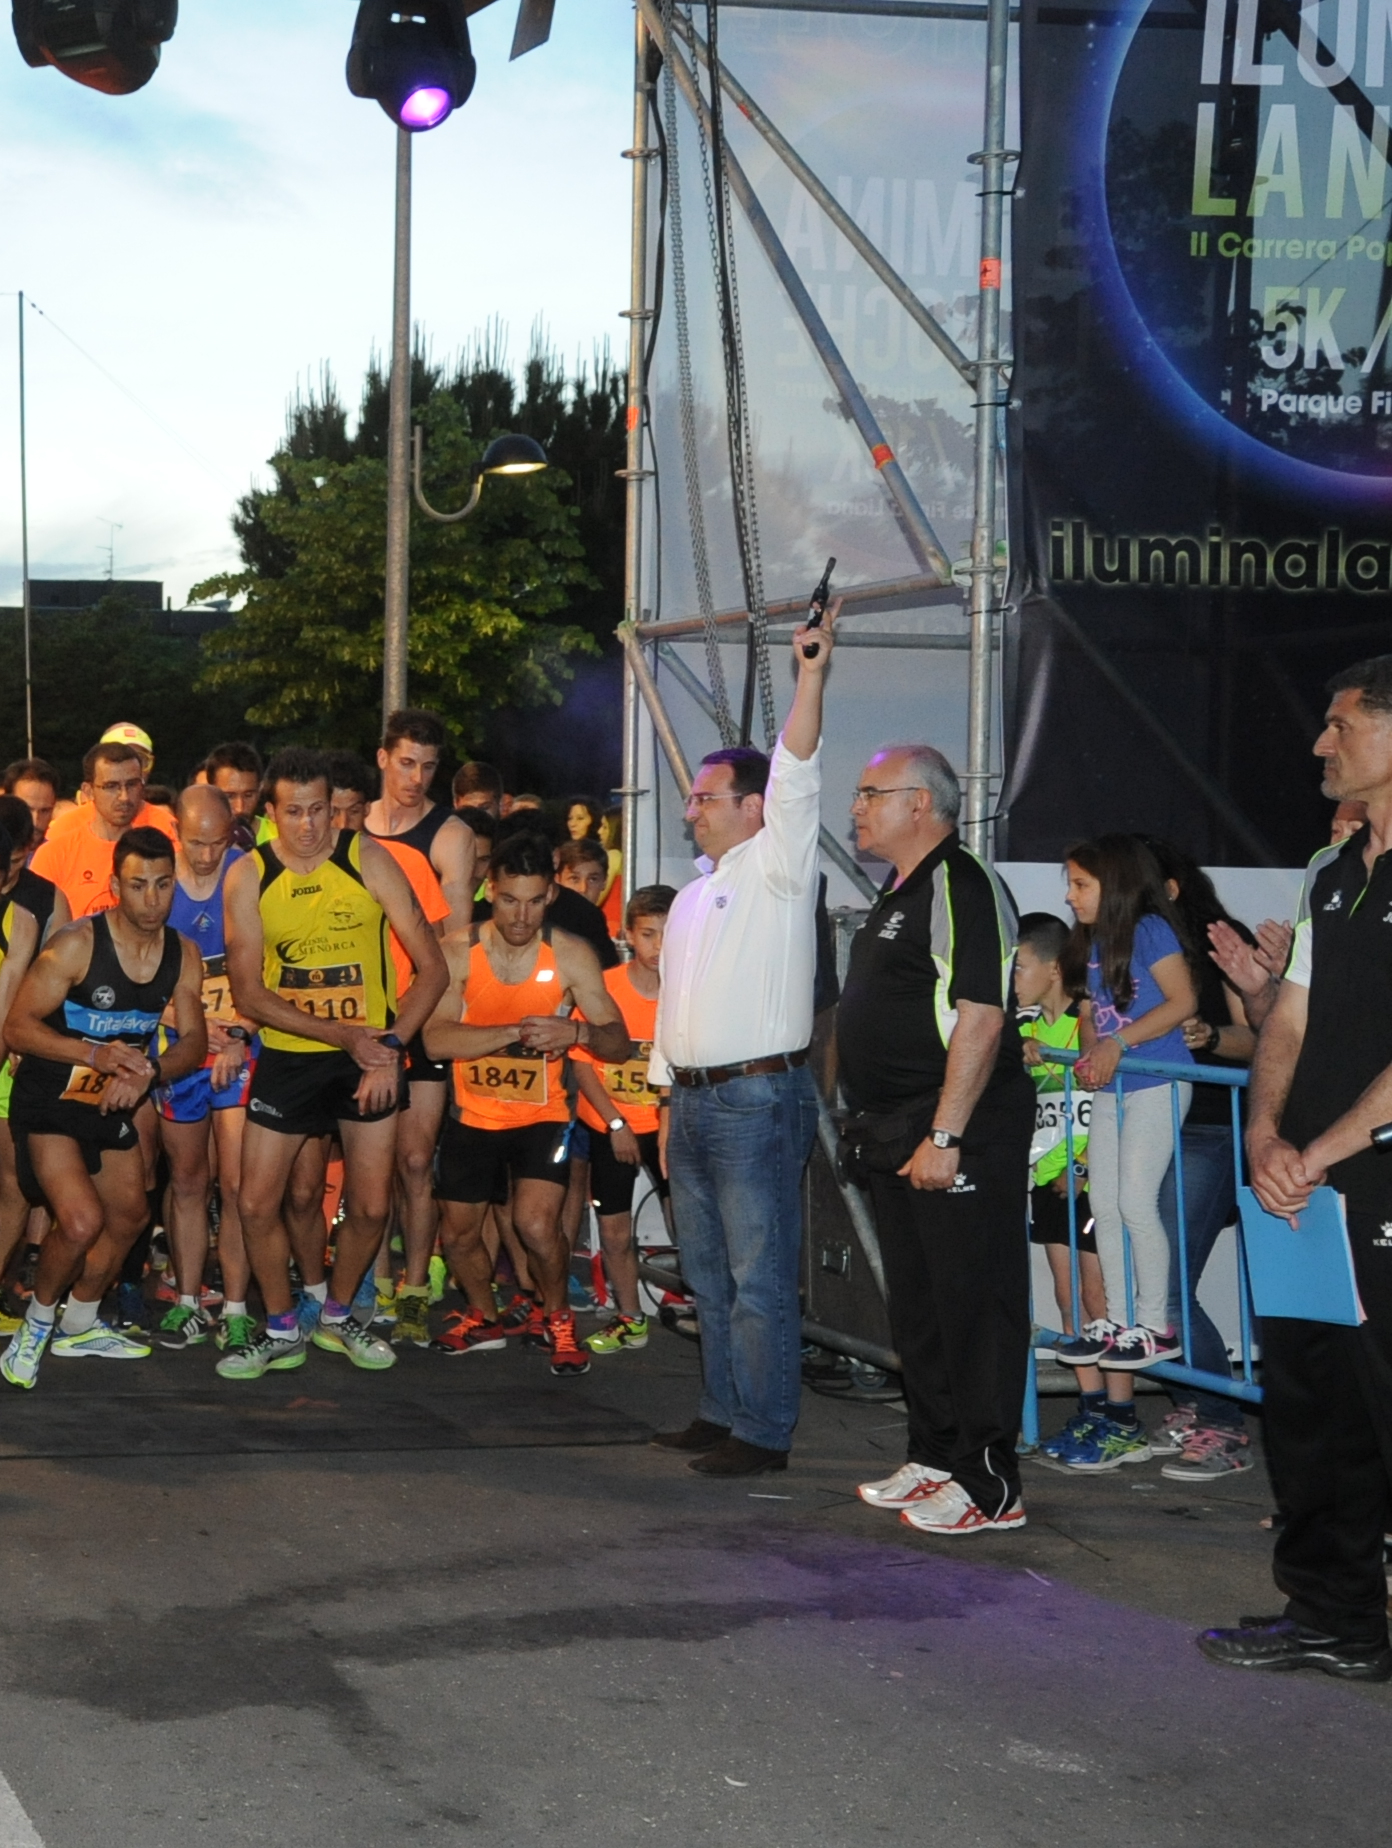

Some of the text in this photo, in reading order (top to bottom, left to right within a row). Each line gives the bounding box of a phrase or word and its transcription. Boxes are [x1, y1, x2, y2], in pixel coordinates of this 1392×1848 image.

[1191, 102, 1392, 219] LAN
[1217, 232, 1337, 260] Carrera
[1260, 286, 1347, 370] 5K
[1261, 388, 1363, 415] Parque
[468, 1065, 537, 1091] 1847
